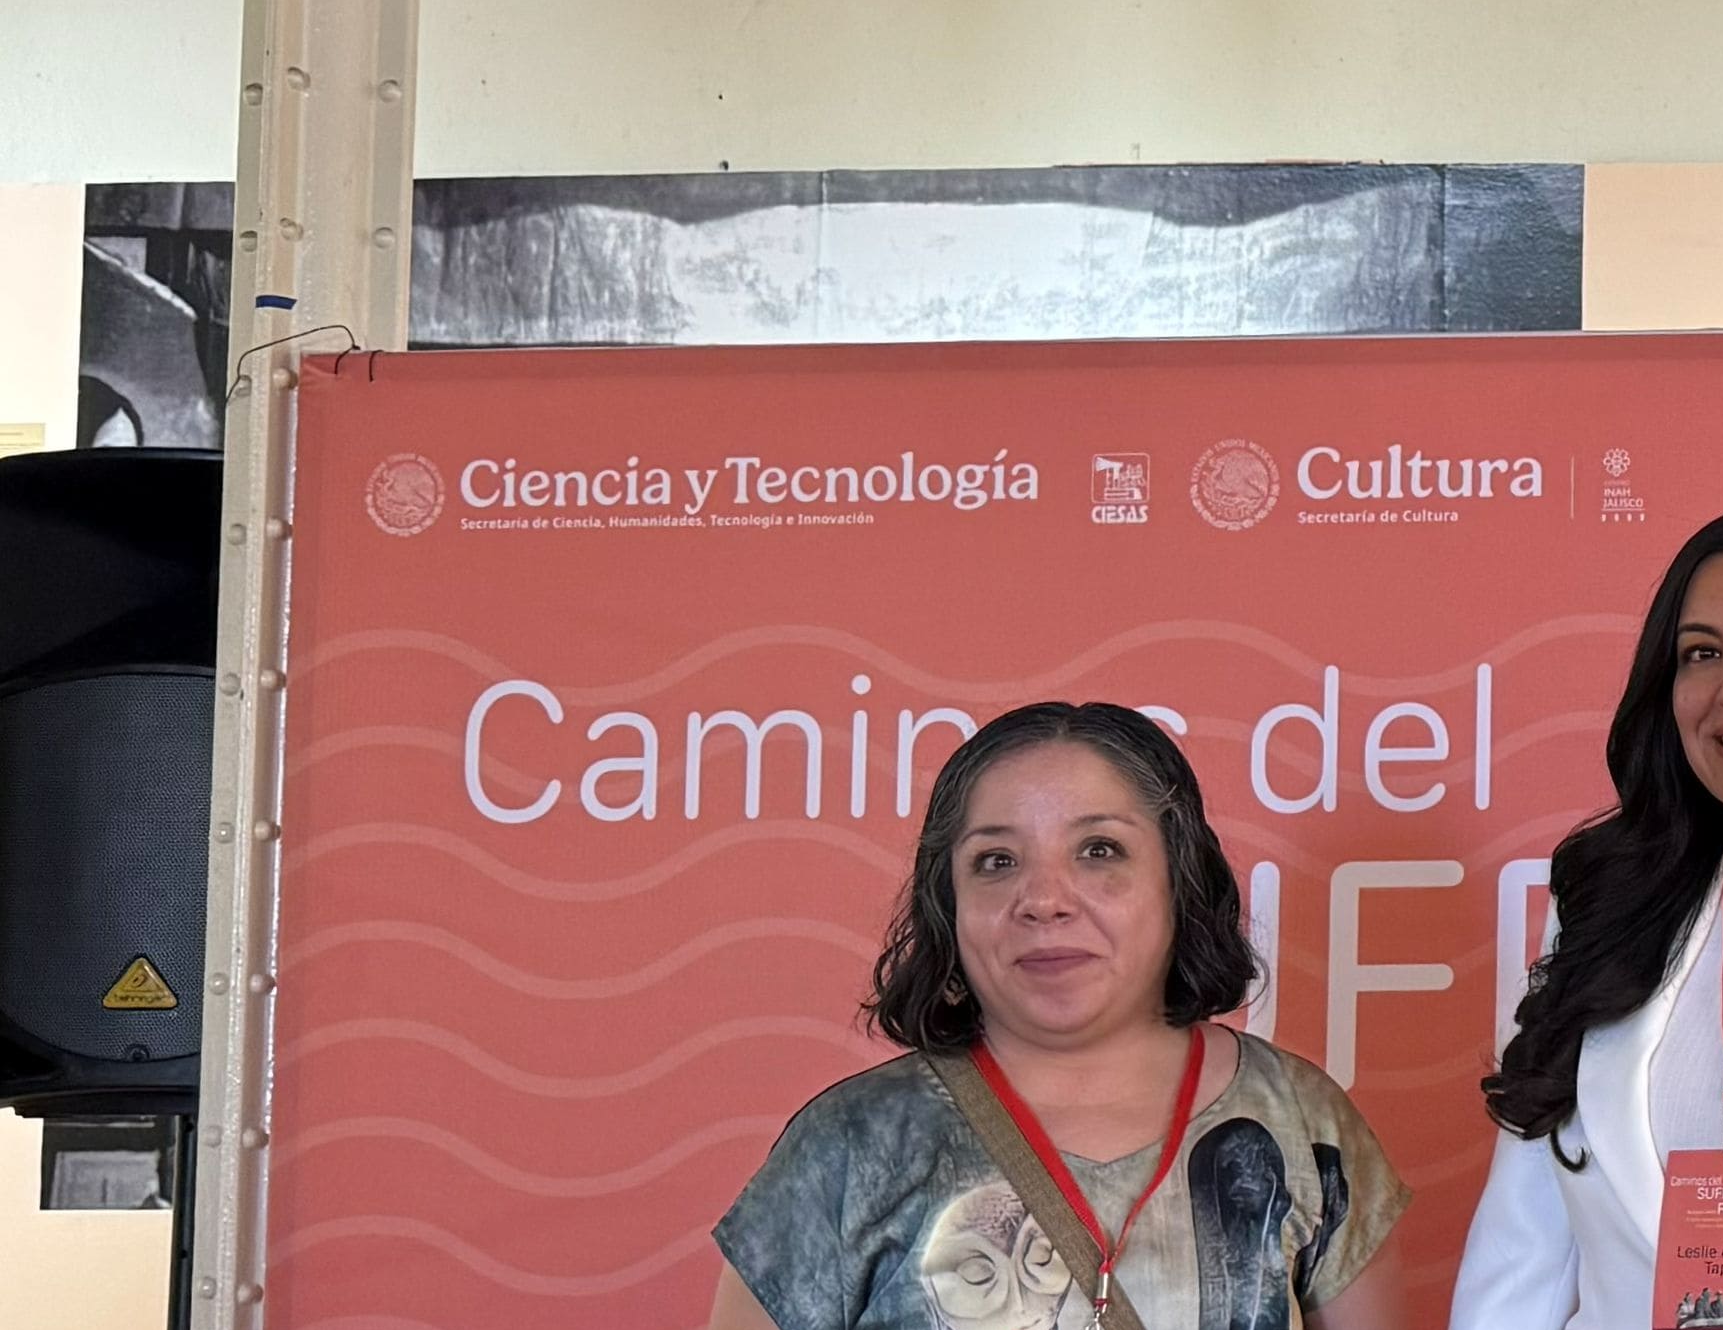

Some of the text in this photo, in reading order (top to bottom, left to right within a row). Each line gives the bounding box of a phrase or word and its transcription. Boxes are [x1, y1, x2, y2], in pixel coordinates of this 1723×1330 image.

[460, 448, 1038, 514] Ciencia y Tecnología
[1297, 444, 1543, 501] Cultura
[1602, 498, 1644, 509] JALISCO
[460, 511, 875, 530] Secretaría de Ciencia, Humanidades, Tecnología e Innovación
[1091, 505, 1149, 524] CIESAS
[1297, 510, 1459, 526] Secretaría de Cultura
[463, 662, 1490, 825] Camin del
[1677, 1245, 1717, 1259] Leslie
